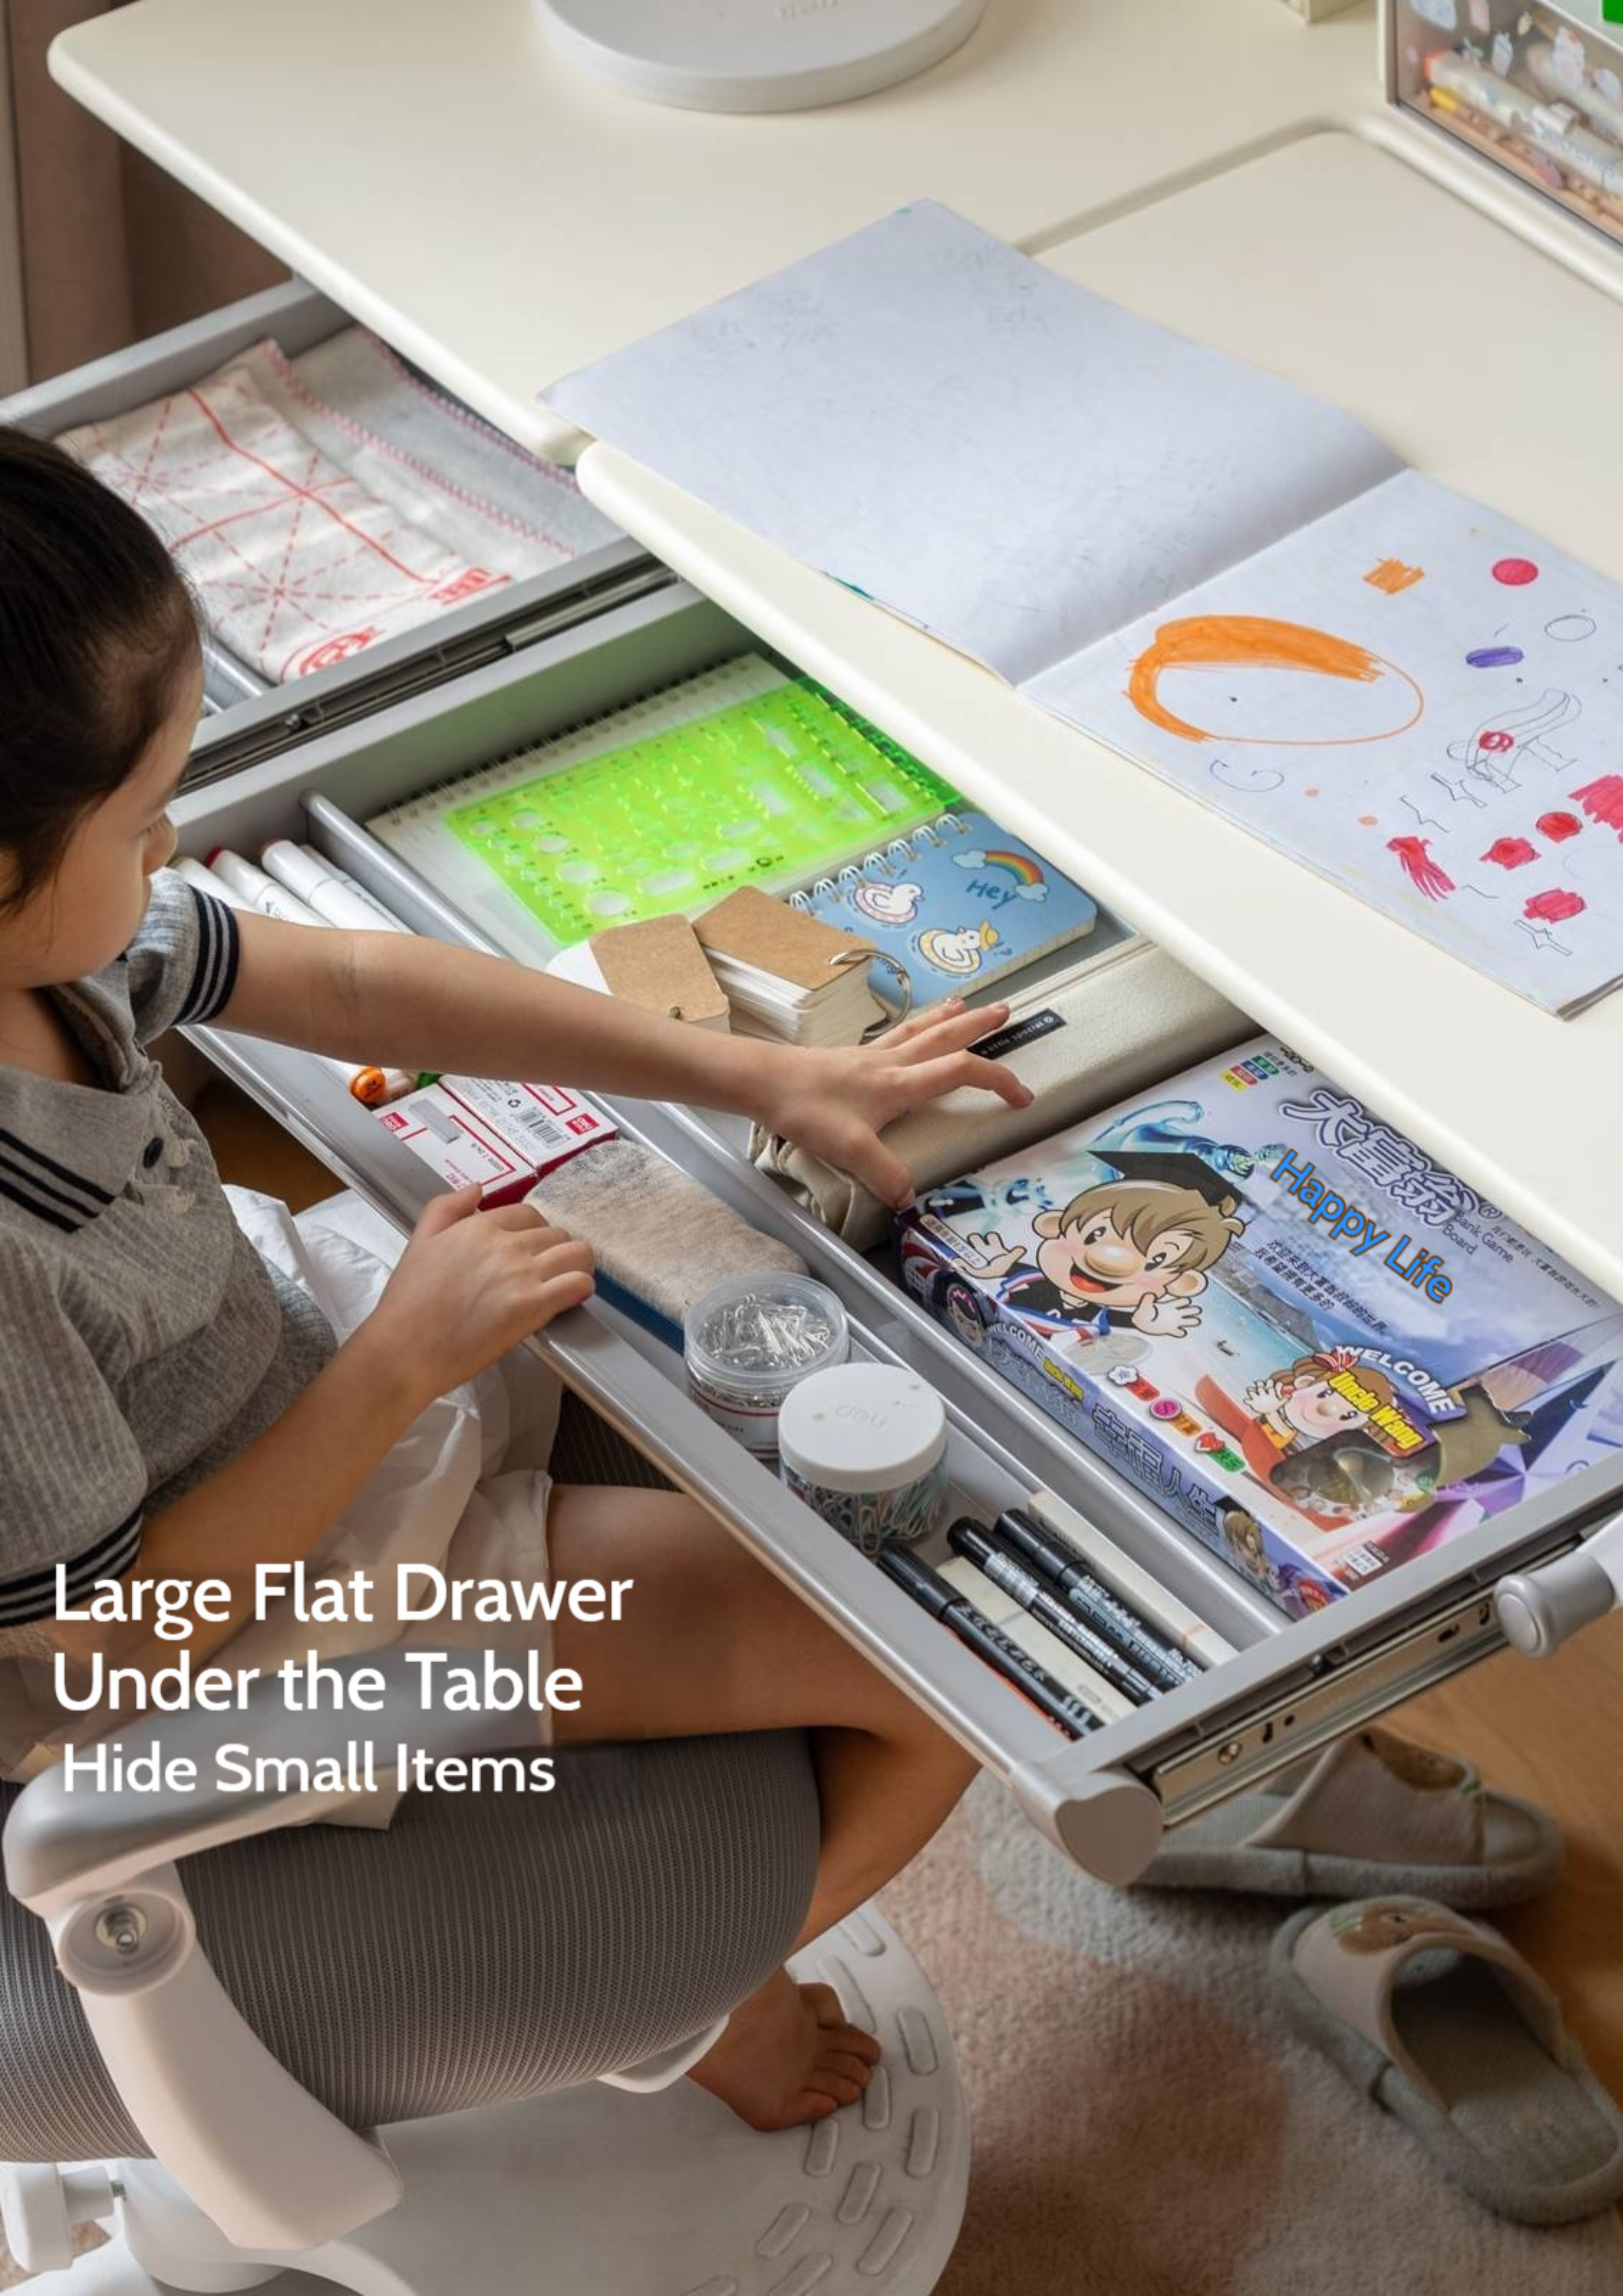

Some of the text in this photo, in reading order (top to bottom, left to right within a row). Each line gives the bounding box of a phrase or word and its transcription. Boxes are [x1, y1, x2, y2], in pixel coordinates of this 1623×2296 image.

[965, 879, 1017, 911] Hey
[1442, 1223, 1478, 1255] Board
[1481, 1232, 1514, 1263] Game
[986, 1322, 1045, 1360] WELCOME
[1335, 1345, 1455, 1415] WELCOME
[1329, 1370, 1425, 1450] Uncle Wang
